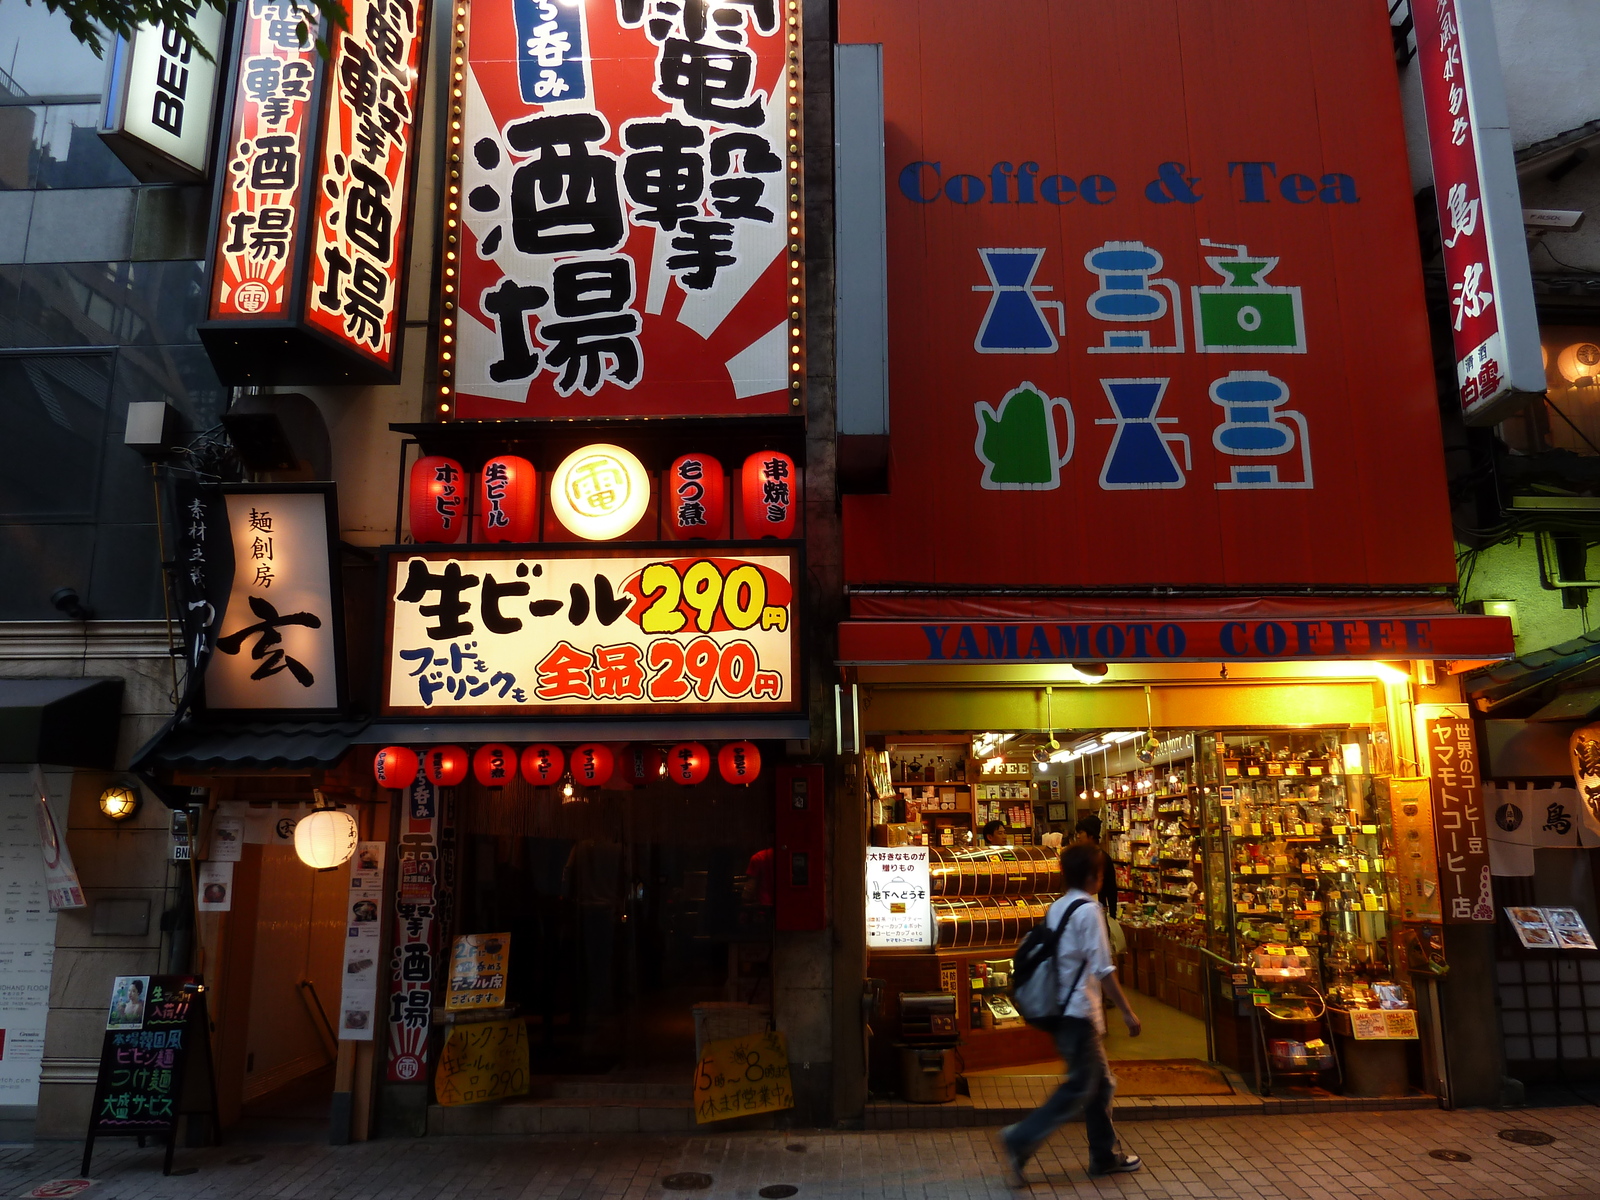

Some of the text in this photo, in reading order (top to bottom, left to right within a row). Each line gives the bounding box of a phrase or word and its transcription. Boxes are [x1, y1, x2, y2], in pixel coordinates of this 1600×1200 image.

[152, 2, 196, 138] BES
[227, 0, 314, 262] 電撃酒場
[318, 0, 414, 349] 電撃酒場
[897, 160, 1361, 206] Coffee & Tea
[469, 113, 640, 392] 酒場
[1460, 358, 1502, 410] 白雪
[435, 463, 460, 529] ホッピー
[485, 462, 510, 529] 生ビール
[677, 459, 707, 527] もつ煮
[762, 457, 790, 523] 串焼き
[248, 507, 275, 589] 麺創房
[396, 559, 789, 641] 生ビール 290円
[215, 596, 322, 688] 玄
[399, 641, 488, 677] フードも
[538, 637, 782, 701] 全品290円
[921, 620, 1435, 660] YAMAMOTO COFFEE
[419, 671, 528, 708] ドリンクも
[1431, 723, 1472, 919] ヤマモトコーヒー店
[1454, 723, 1484, 855] 世界のコーヒー豆
[1542, 802, 1572, 835] 鳥
[869, 852, 927, 861] 大好きなものが
[872, 890, 926, 900] 地下へどうぞ
